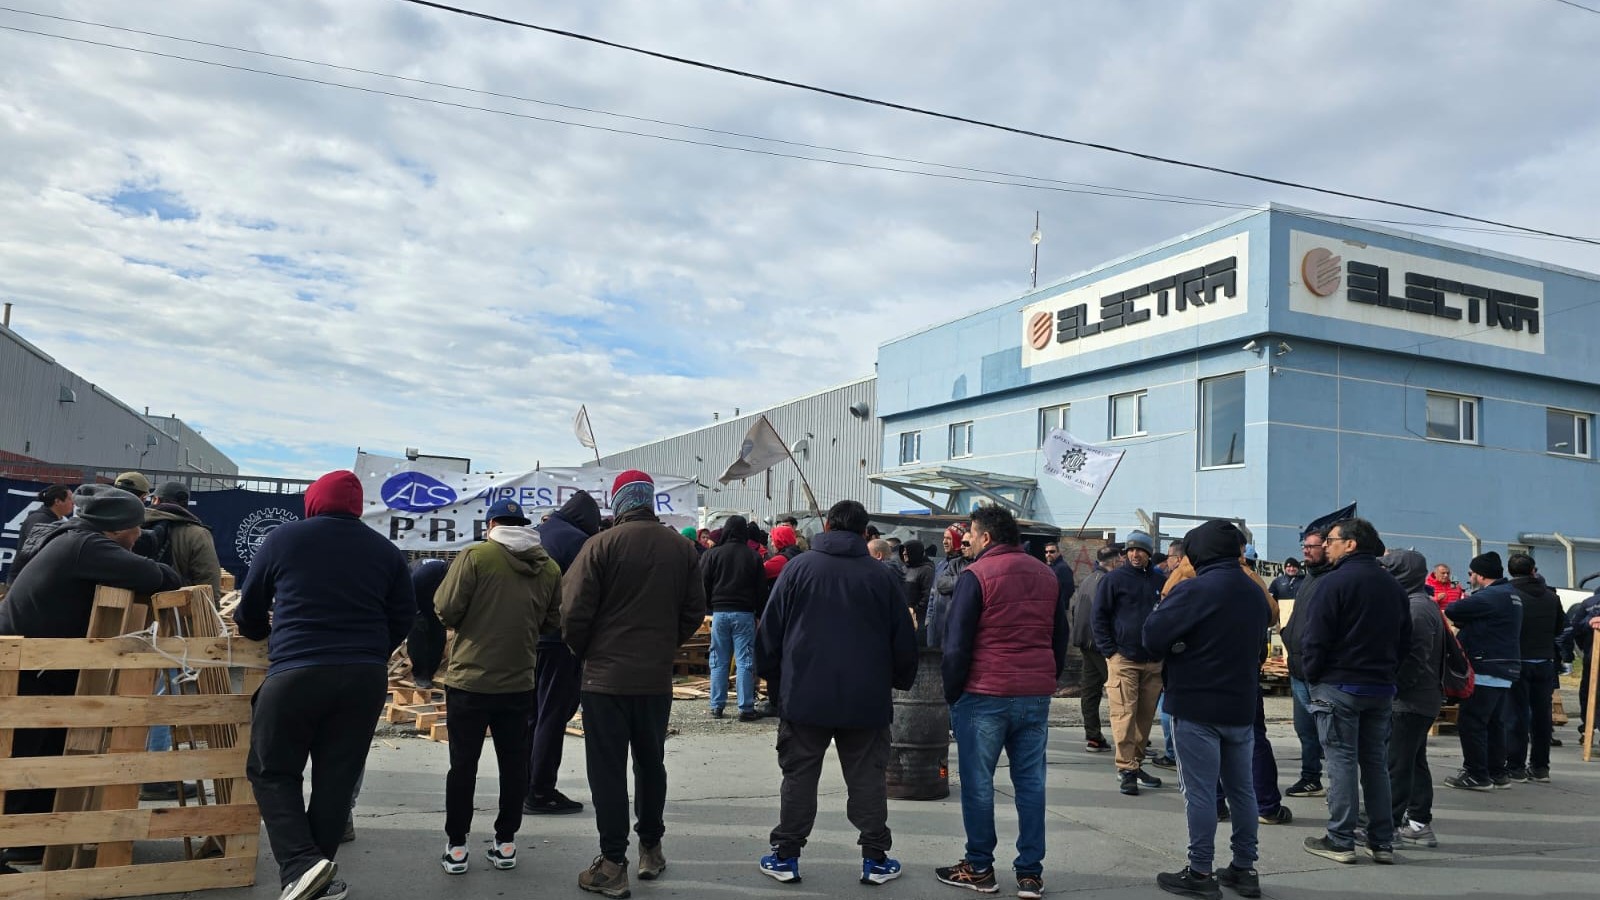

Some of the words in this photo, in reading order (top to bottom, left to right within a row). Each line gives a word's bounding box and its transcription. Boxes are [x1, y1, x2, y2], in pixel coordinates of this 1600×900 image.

[1056, 256, 1237, 343] ELECTRA
[1347, 260, 1540, 334] ELECTRA
[386, 481, 451, 507] ACS
[463, 486, 552, 507] AIRES
